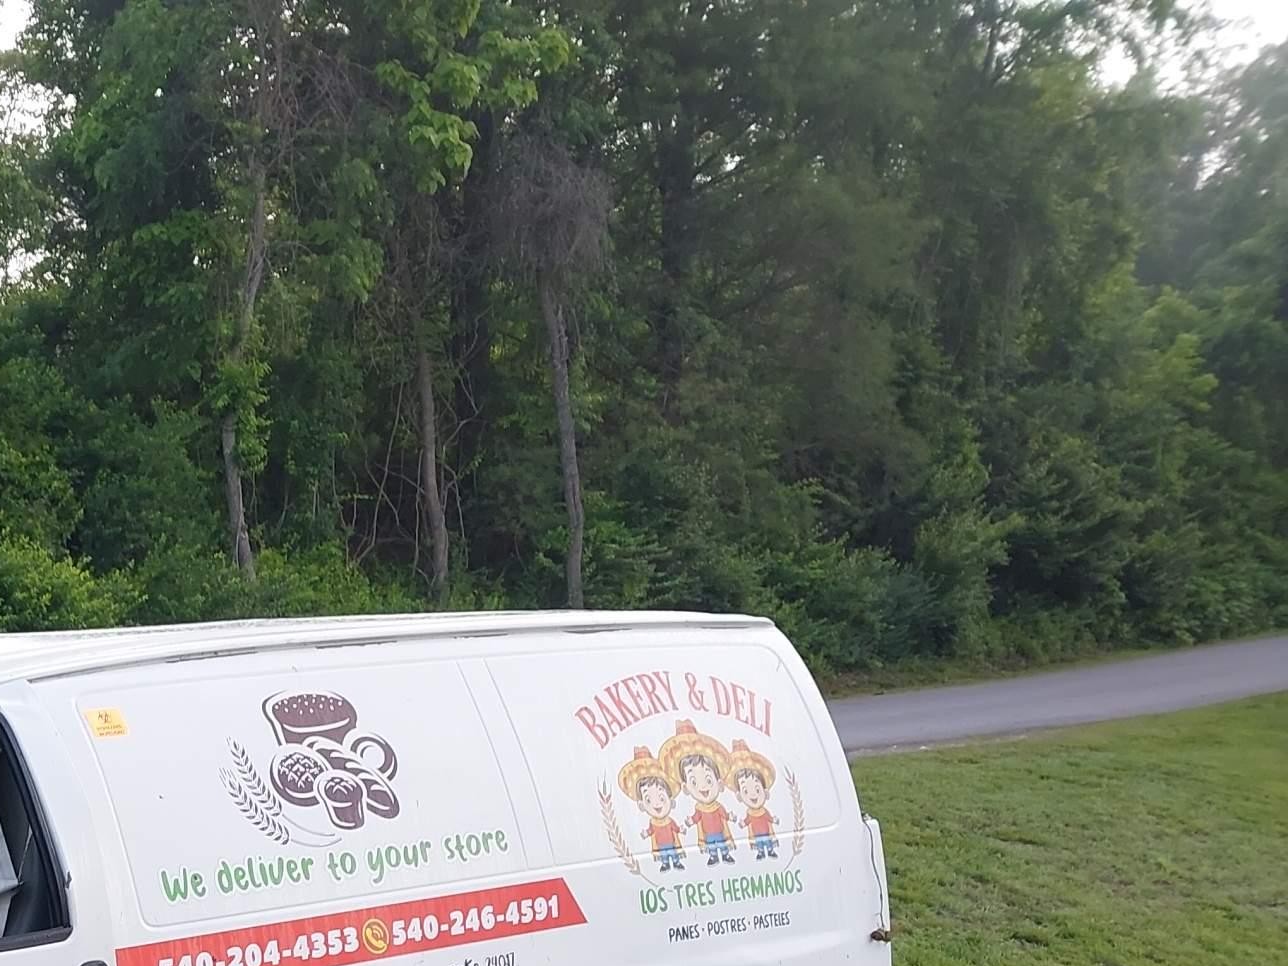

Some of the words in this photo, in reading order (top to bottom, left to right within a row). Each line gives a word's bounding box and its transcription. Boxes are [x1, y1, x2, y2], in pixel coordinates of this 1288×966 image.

[575, 671, 679, 749] BAKERY
[684, 672, 709, 713] &
[709, 676, 773, 736] DELI
[161, 866, 206, 902] We
[217, 855, 314, 894] deliver
[328, 851, 356, 880] to
[367, 838, 432, 884] your
[444, 829, 508, 860] store
[641, 887, 667, 914] LOS
[674, 880, 713, 907] TRES
[721, 870, 803, 902] HERMANOS
[391, 893, 560, 946] 540-246-4591
[669, 924, 700, 943] PANES
[707, 917, 747, 936] POSTRES
[753, 911, 790, 929] PASTELES
